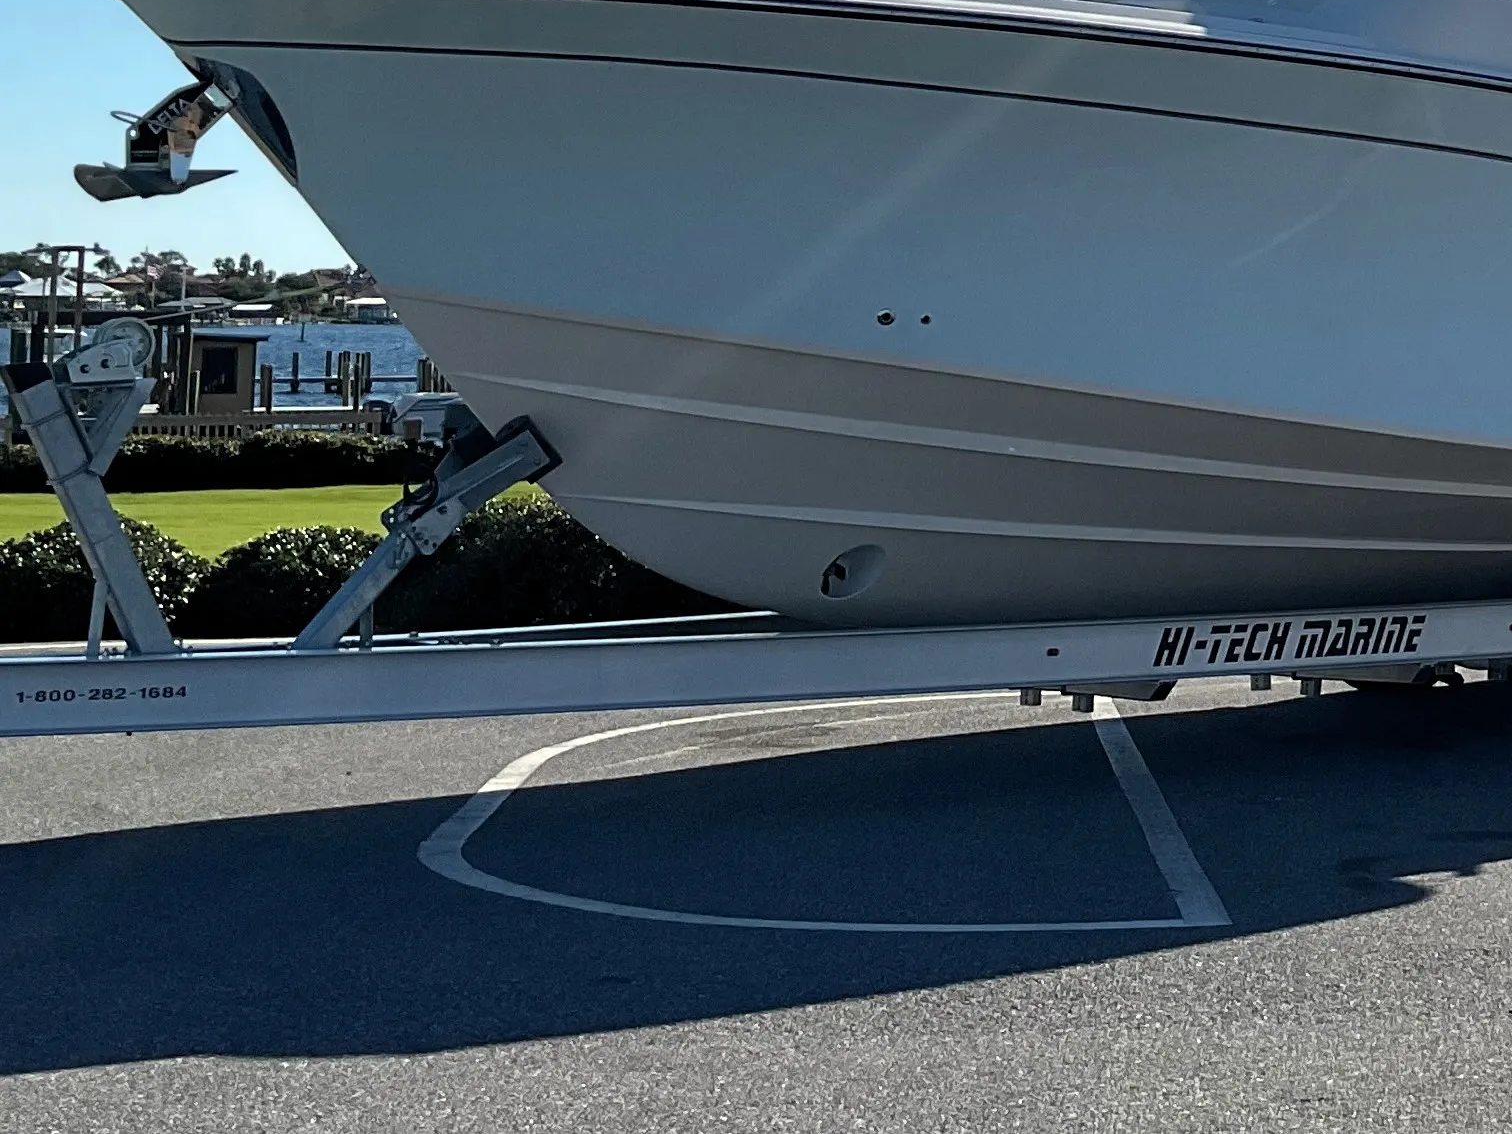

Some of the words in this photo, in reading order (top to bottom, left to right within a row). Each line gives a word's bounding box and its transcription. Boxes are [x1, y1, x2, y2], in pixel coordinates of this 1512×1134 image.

[148, 98, 193, 135] DELTA
[1153, 621, 1292, 667] HI-TECH
[1294, 615, 1427, 659] MARINE
[16, 685, 187, 704] 1-800-282-1684
